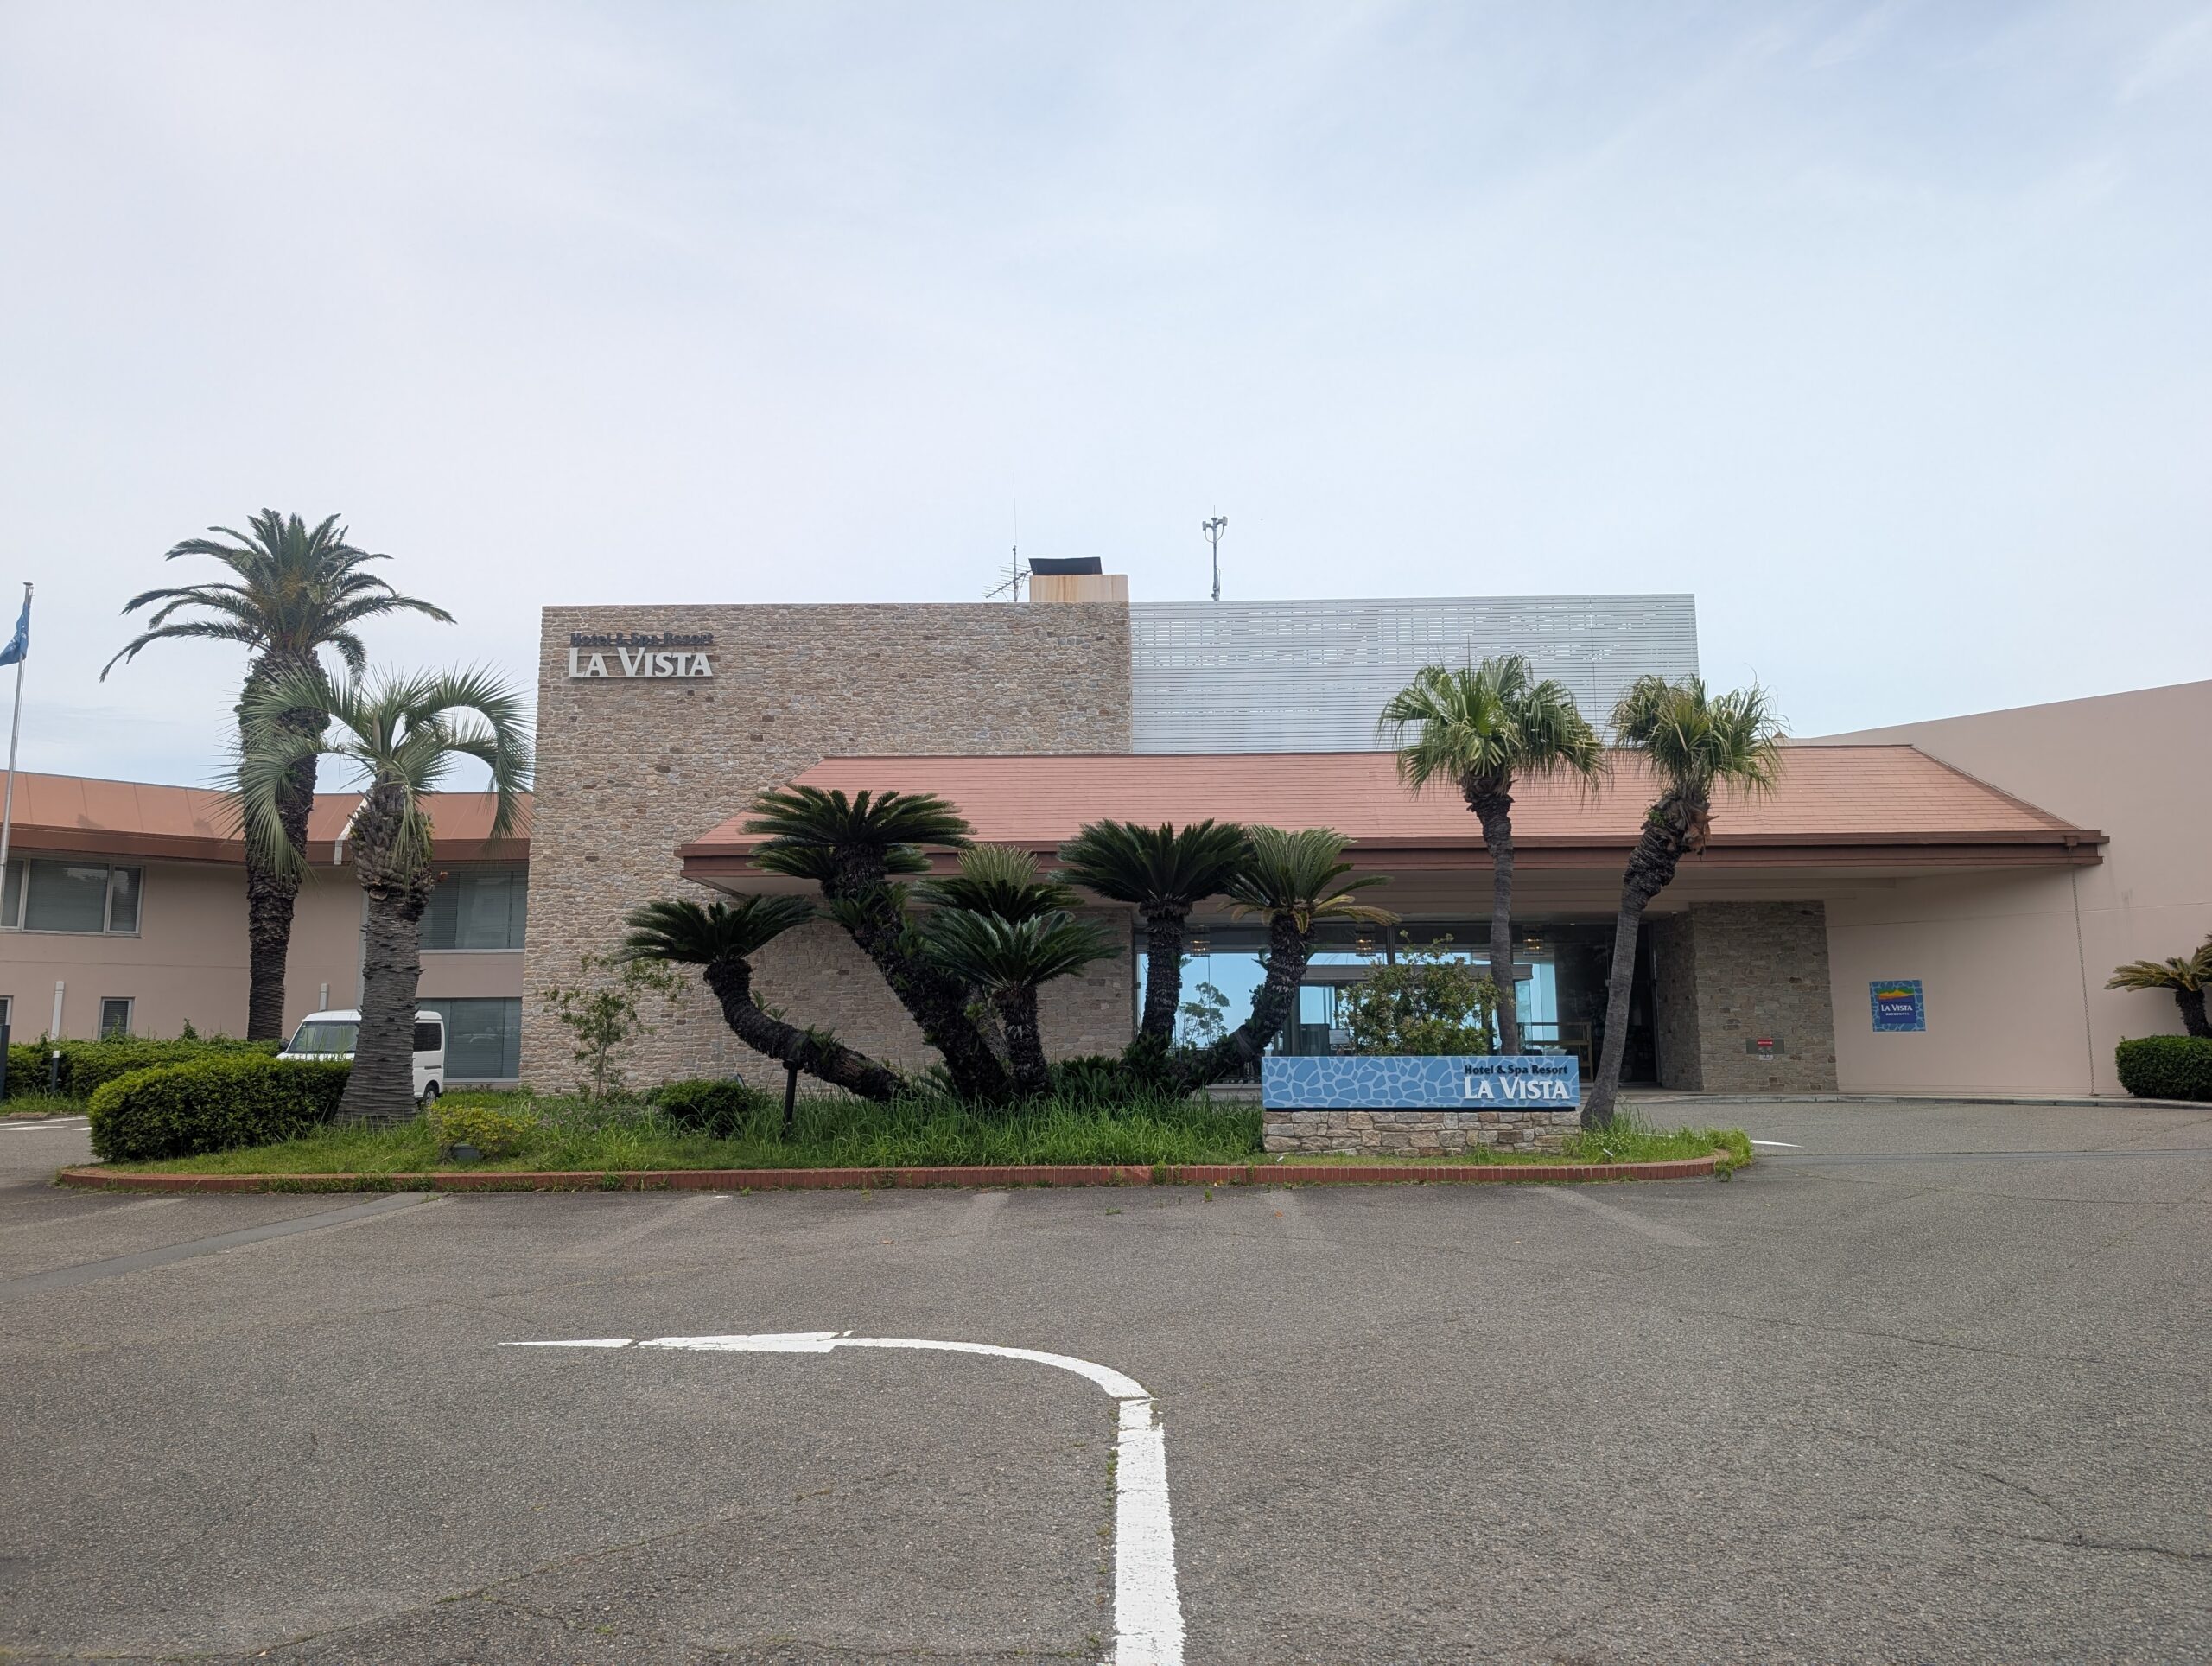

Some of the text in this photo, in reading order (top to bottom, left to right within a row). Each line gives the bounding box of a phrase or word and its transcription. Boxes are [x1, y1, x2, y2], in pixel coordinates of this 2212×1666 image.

[570, 632, 610, 645] Hotel
[631, 632, 659, 646] Spa
[664, 632, 714, 645] Resort
[569, 647, 713, 677] LA VISTA
[1464, 1065, 1568, 1077] Hotel & Spa Resort
[1464, 1076, 1570, 1100] LA VISTA
